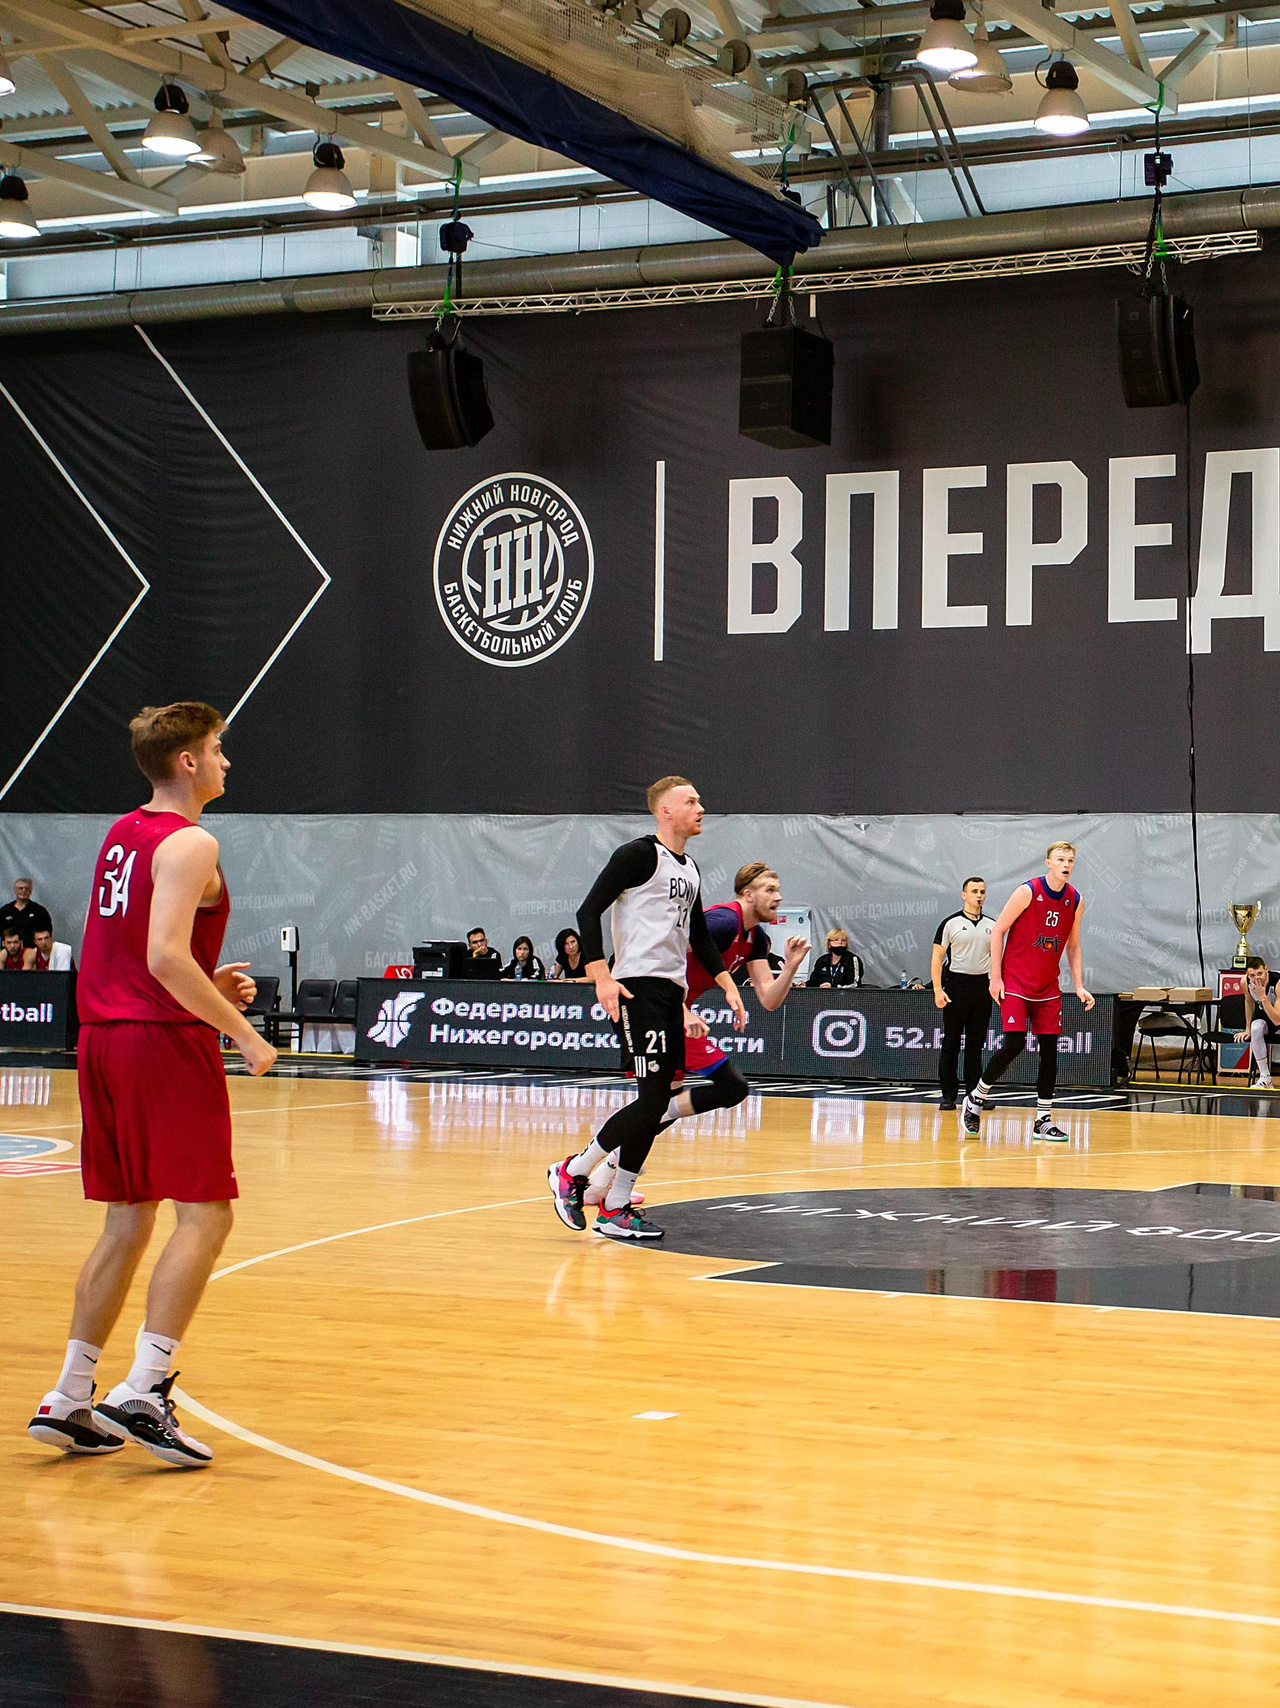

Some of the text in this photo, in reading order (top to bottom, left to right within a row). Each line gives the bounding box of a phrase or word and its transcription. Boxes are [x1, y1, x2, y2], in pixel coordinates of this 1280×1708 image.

[447, 483, 580, 550] НИЖНИЙ НОВГОРОД
[482, 520, 544, 619] НН
[443, 578, 583, 656] БАСКЕТБОЛЬНЫЙ КЛУБ
[99, 843, 138, 918] 34
[343, 860, 419, 937] NN-BASKET.RU
[1046, 910, 1060, 927] 25
[0, 1002, 53, 1022] tball
[431, 998, 583, 1024] Федерация
[645, 1030, 667, 1054] 21
[705, 1202, 1122, 1233] НИЖНИЙ
